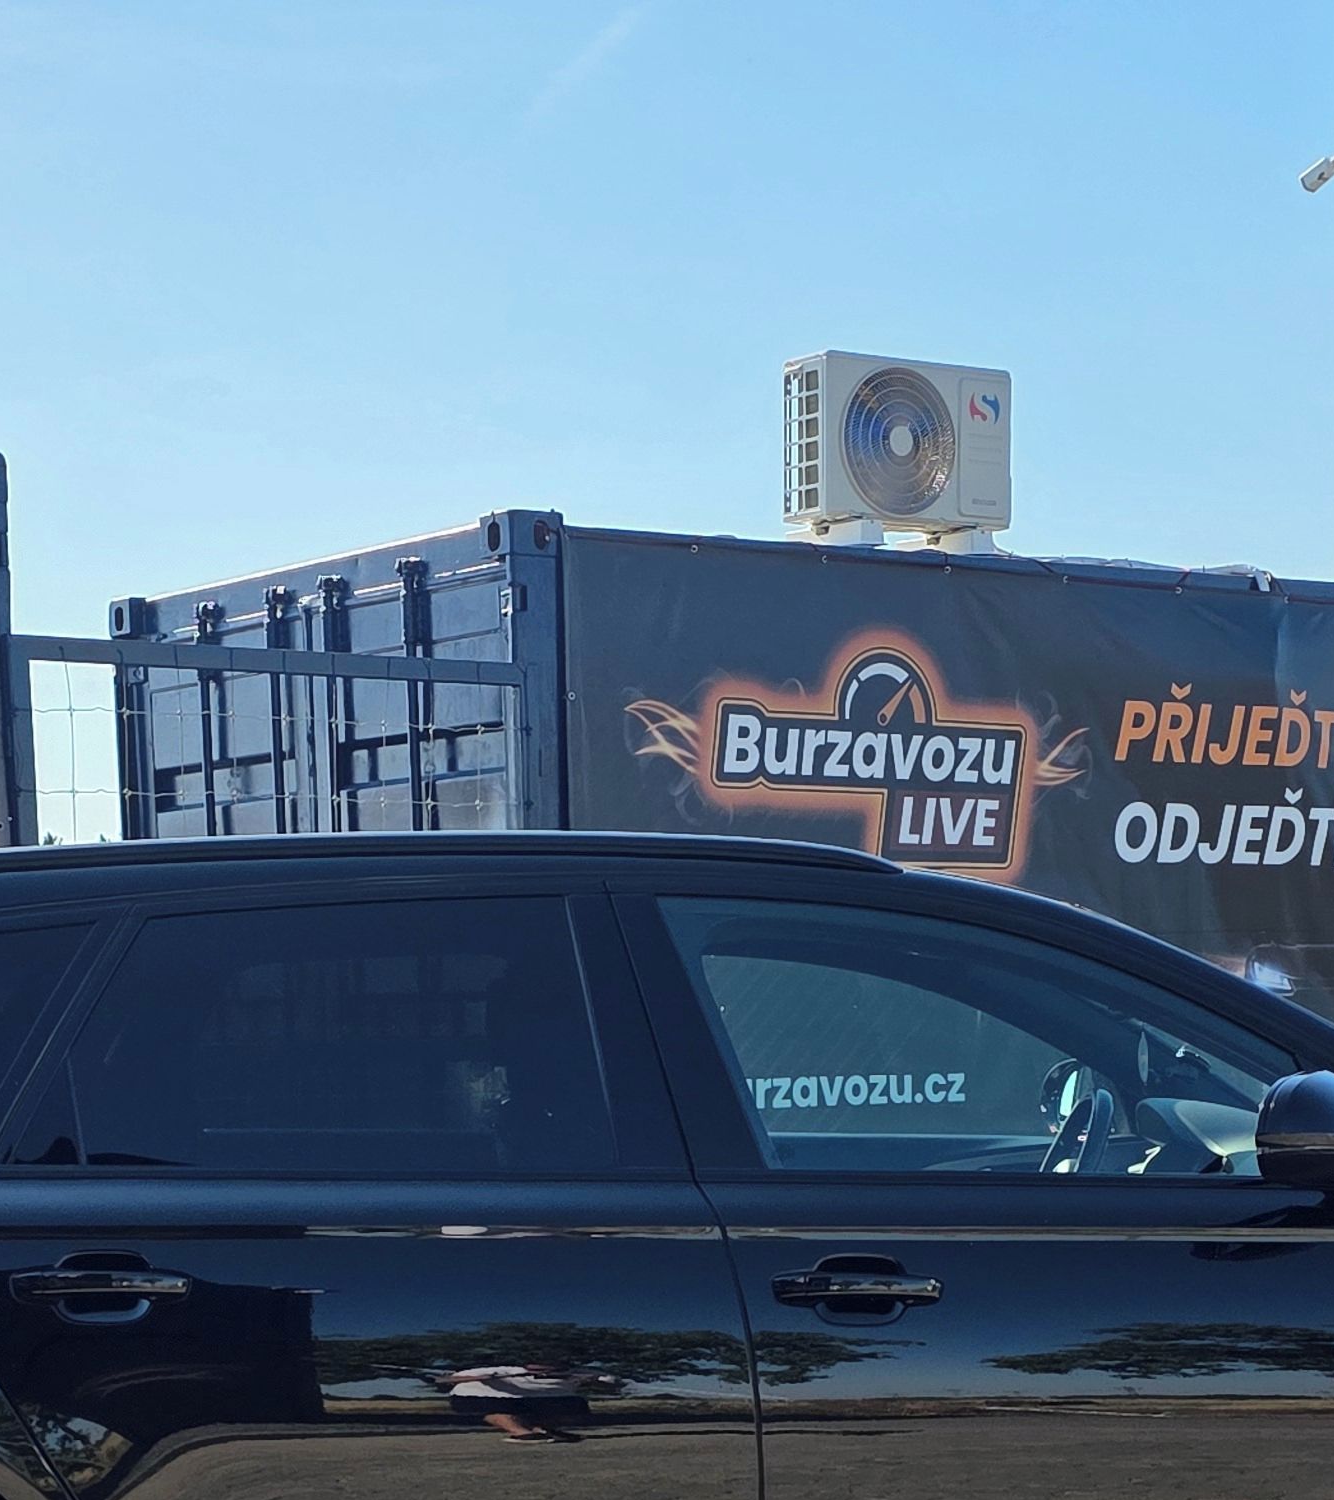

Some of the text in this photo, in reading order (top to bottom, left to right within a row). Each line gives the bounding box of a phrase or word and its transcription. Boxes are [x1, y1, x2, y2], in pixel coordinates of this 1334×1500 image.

[722, 713, 1017, 785] Burzavozu
[898, 797, 1000, 846] LIVE
[746, 1073, 966, 1109] rzavozu.cz
